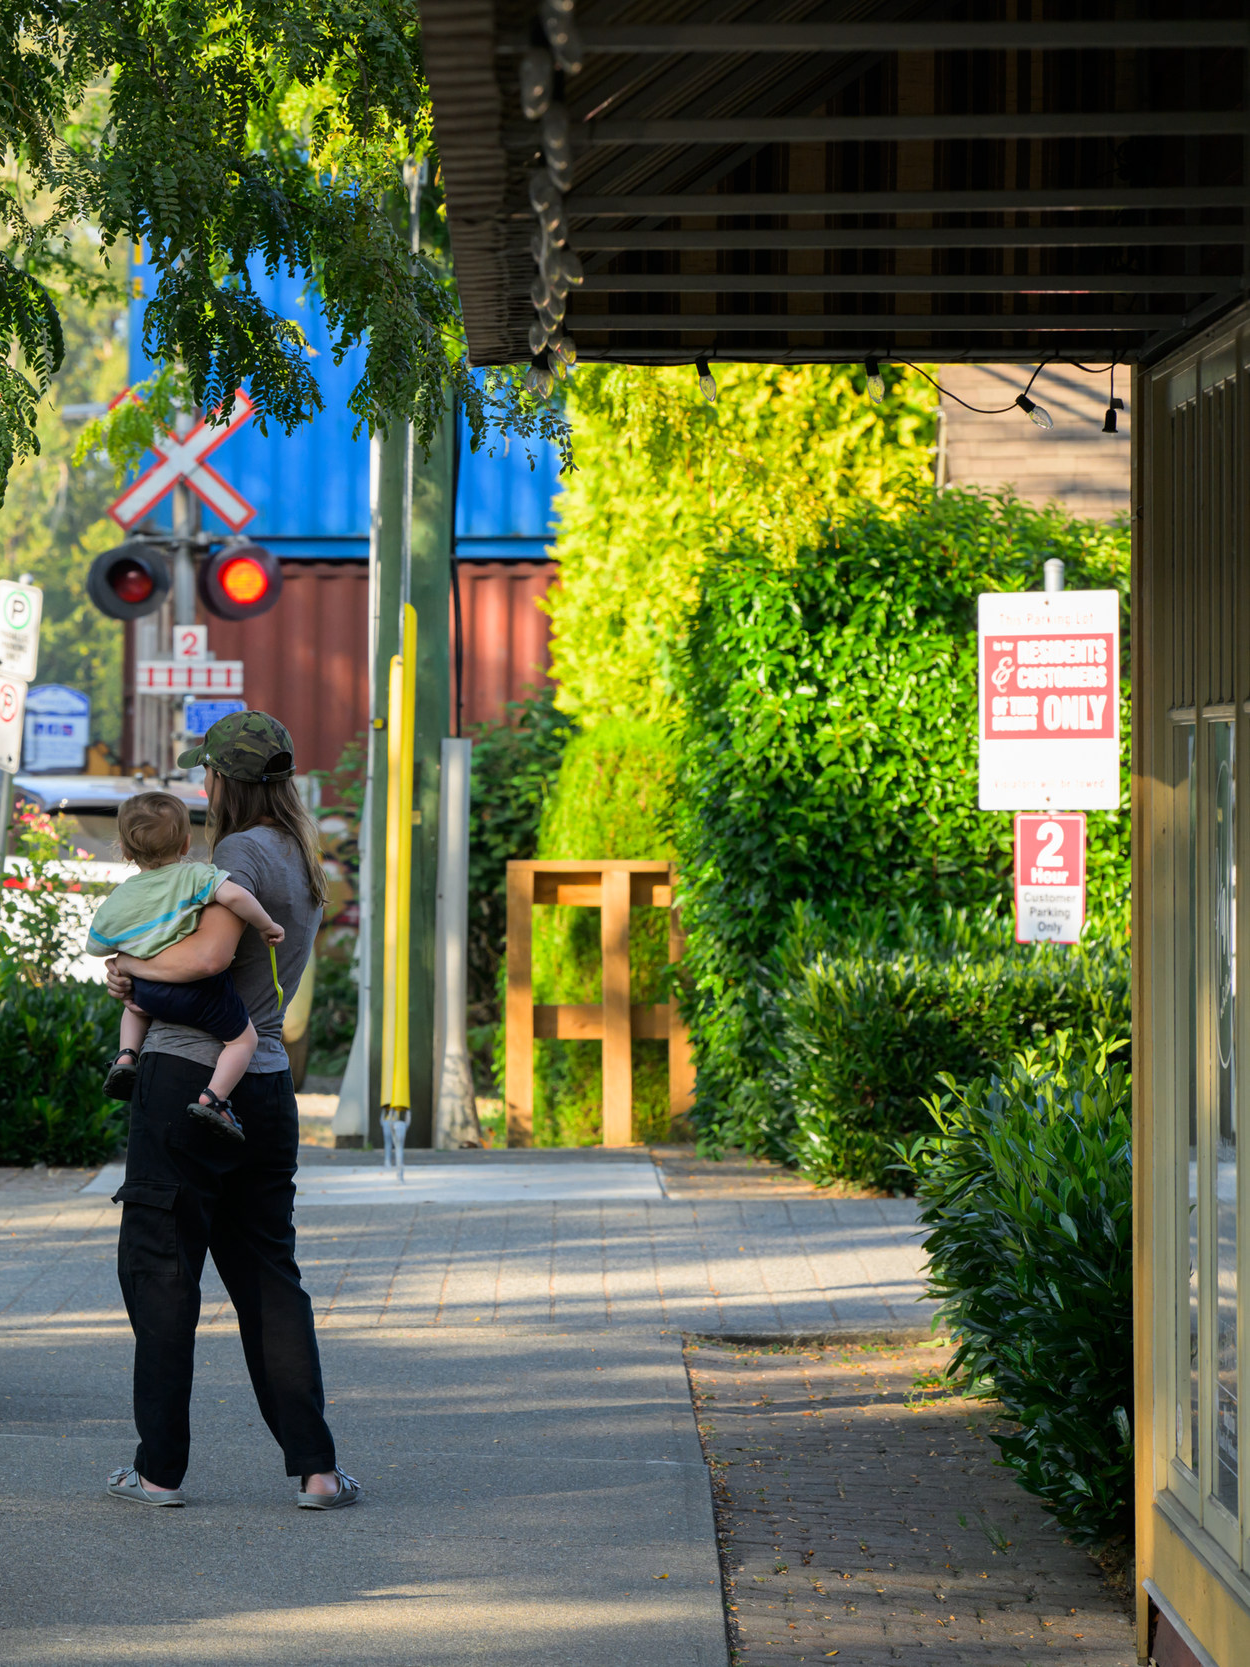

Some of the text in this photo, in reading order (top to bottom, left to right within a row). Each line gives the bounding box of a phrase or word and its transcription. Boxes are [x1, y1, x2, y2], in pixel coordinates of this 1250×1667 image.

[999, 612, 1094, 628] This Parking Lot
[181, 632, 198, 656] 2
[1017, 638, 1107, 665] RESIDENTS
[1017, 665, 1107, 689] CUSTOMERS
[1043, 694, 1107, 730] ONLY
[1036, 821, 1064, 867] 2
[1031, 867, 1069, 884] Hour
[1024, 892, 1076, 903] Customer
[1030, 906, 1071, 919] Parking
[1037, 921, 1063, 935] Only
